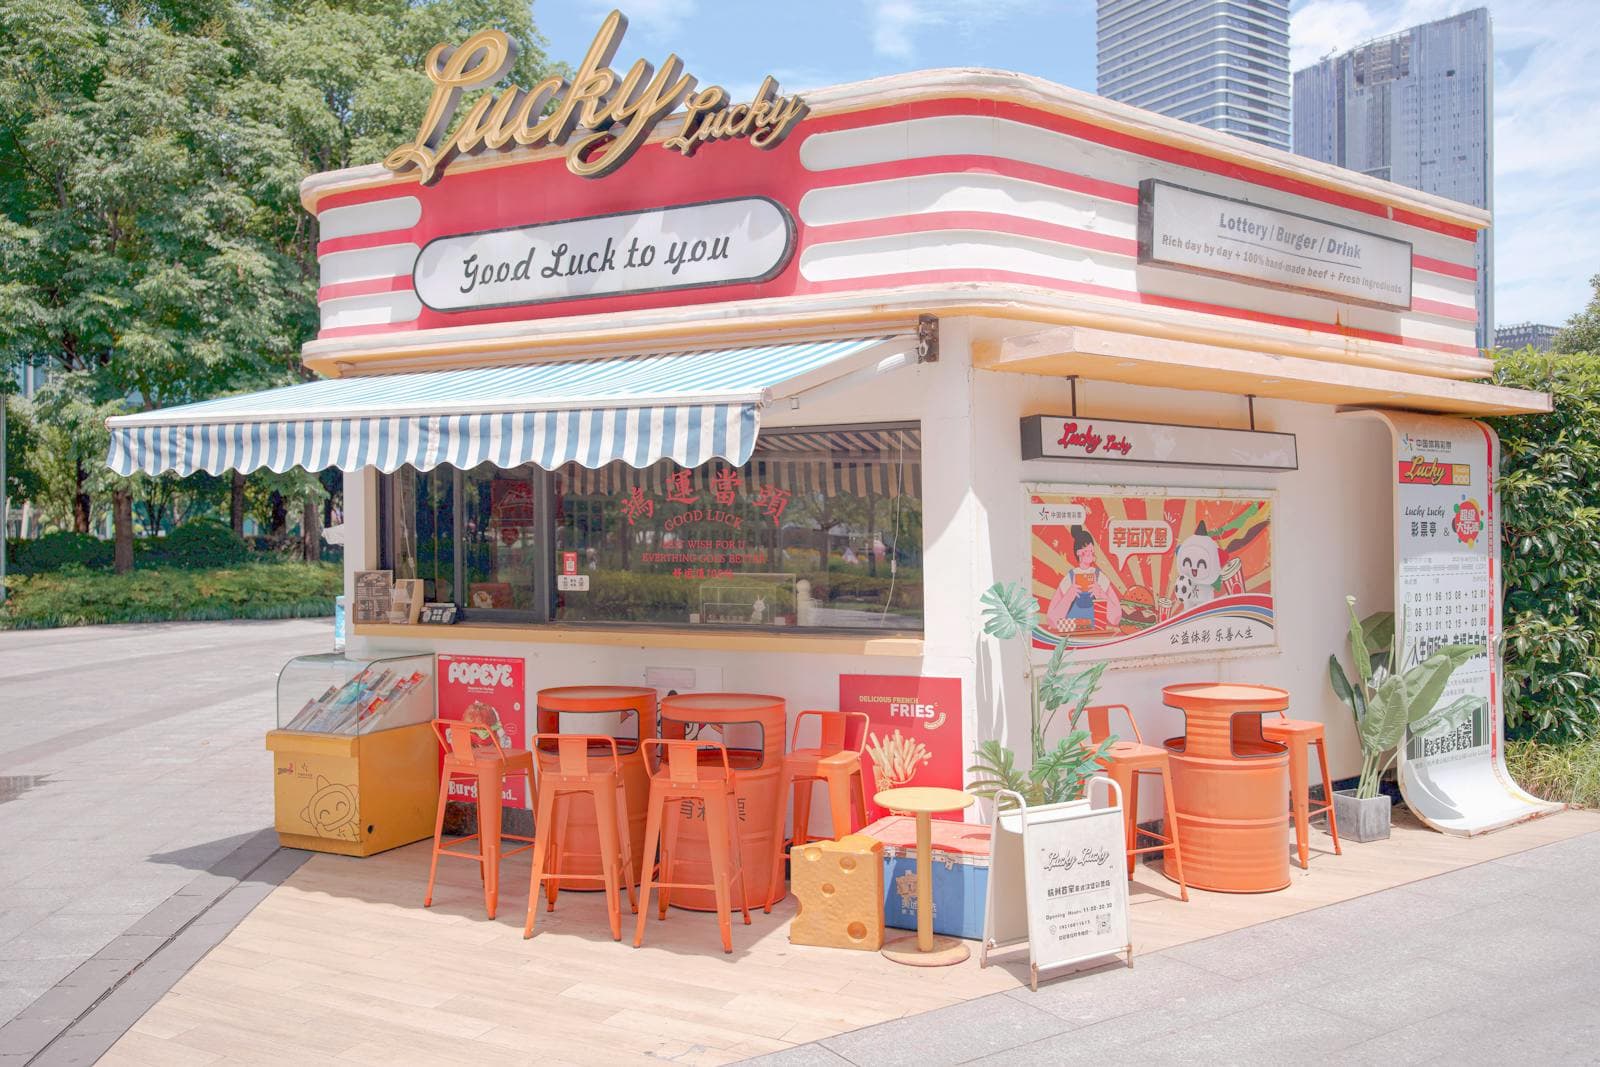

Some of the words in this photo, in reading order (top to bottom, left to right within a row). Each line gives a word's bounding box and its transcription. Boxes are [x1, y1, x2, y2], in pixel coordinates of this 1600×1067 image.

[382, 9, 698, 186] Lucky
[662, 75, 811, 157] Lucky
[1219, 213, 1267, 241] Lottery
[1276, 225, 1317, 251] Burger
[1327, 237, 1362, 260] Drink
[459, 249, 535, 294] Good
[541, 243, 616, 279] Luck
[624, 240, 657, 270] to
[663, 234, 729, 275] you
[1161, 234, 1183, 249] Rich
[1185, 240, 1202, 254] day
[1203, 242, 1216, 257] by
[1216, 246, 1234, 260] day
[1242, 252, 1264, 265] 100%
[1307, 266, 1328, 279] beef
[1337, 271, 1361, 285] Fresh
[1057, 422, 1102, 453] Lucky
[1102, 434, 1132, 455] Lucky
[1404, 455, 1446, 485] Lucky
[664, 510, 703, 531] GOOD
[706, 509, 745, 530] LUCK
[1405, 505, 1426, 517] Lucky
[1426, 505, 1446, 518] Lucky
[687, 539, 713, 550] WISH
[716, 539, 735, 550] FOR
[1113, 527, 1168, 548] 幸运汉堡
[1169, 630, 1211, 646] 公益体彩
[1215, 626, 1254, 642] 乐善人生
[447, 662, 514, 688] POPEYE
[859, 695, 892, 703] DELICIOUS
[892, 696, 919, 704] FRENCH
[890, 703, 935, 719] FRIES
